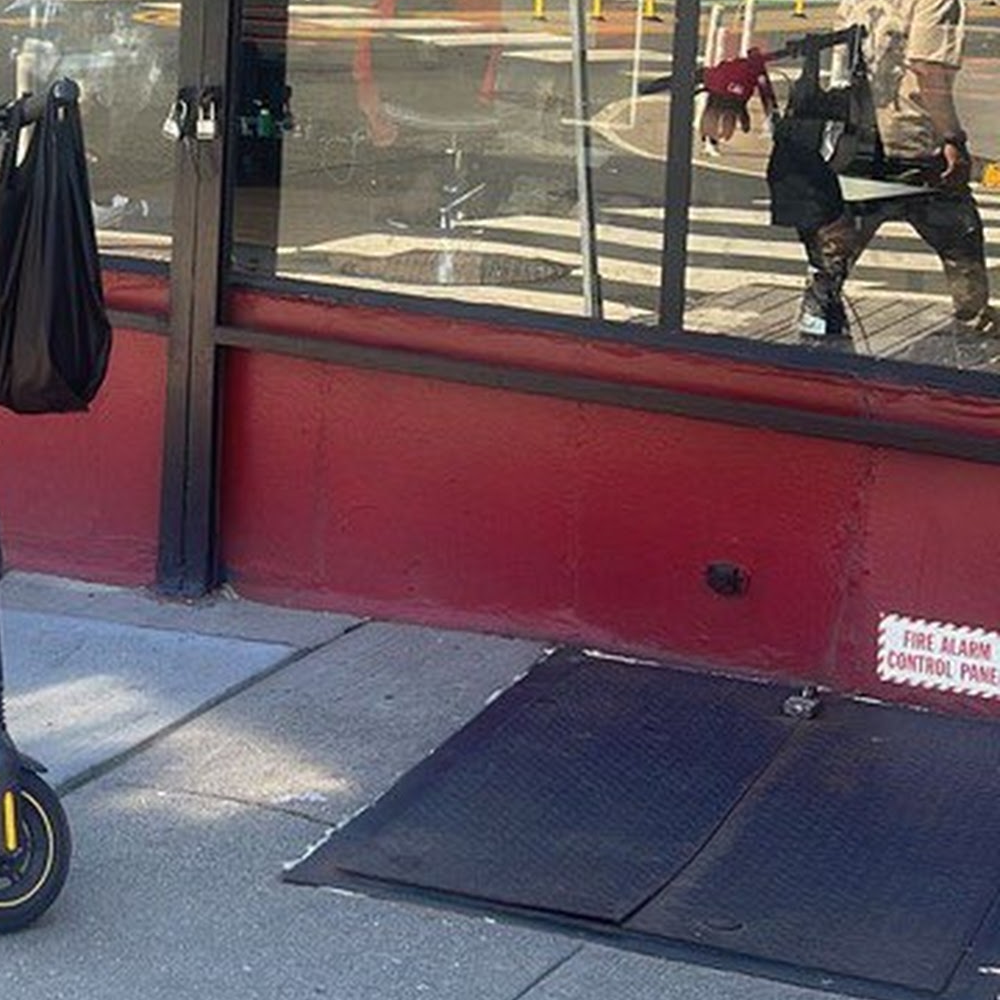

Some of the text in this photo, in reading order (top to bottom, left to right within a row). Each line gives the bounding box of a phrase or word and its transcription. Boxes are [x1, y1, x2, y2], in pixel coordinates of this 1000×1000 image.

[903, 630, 992, 660] FIRE ALARM
[887, 649, 1000, 684] CONTROL PANE
